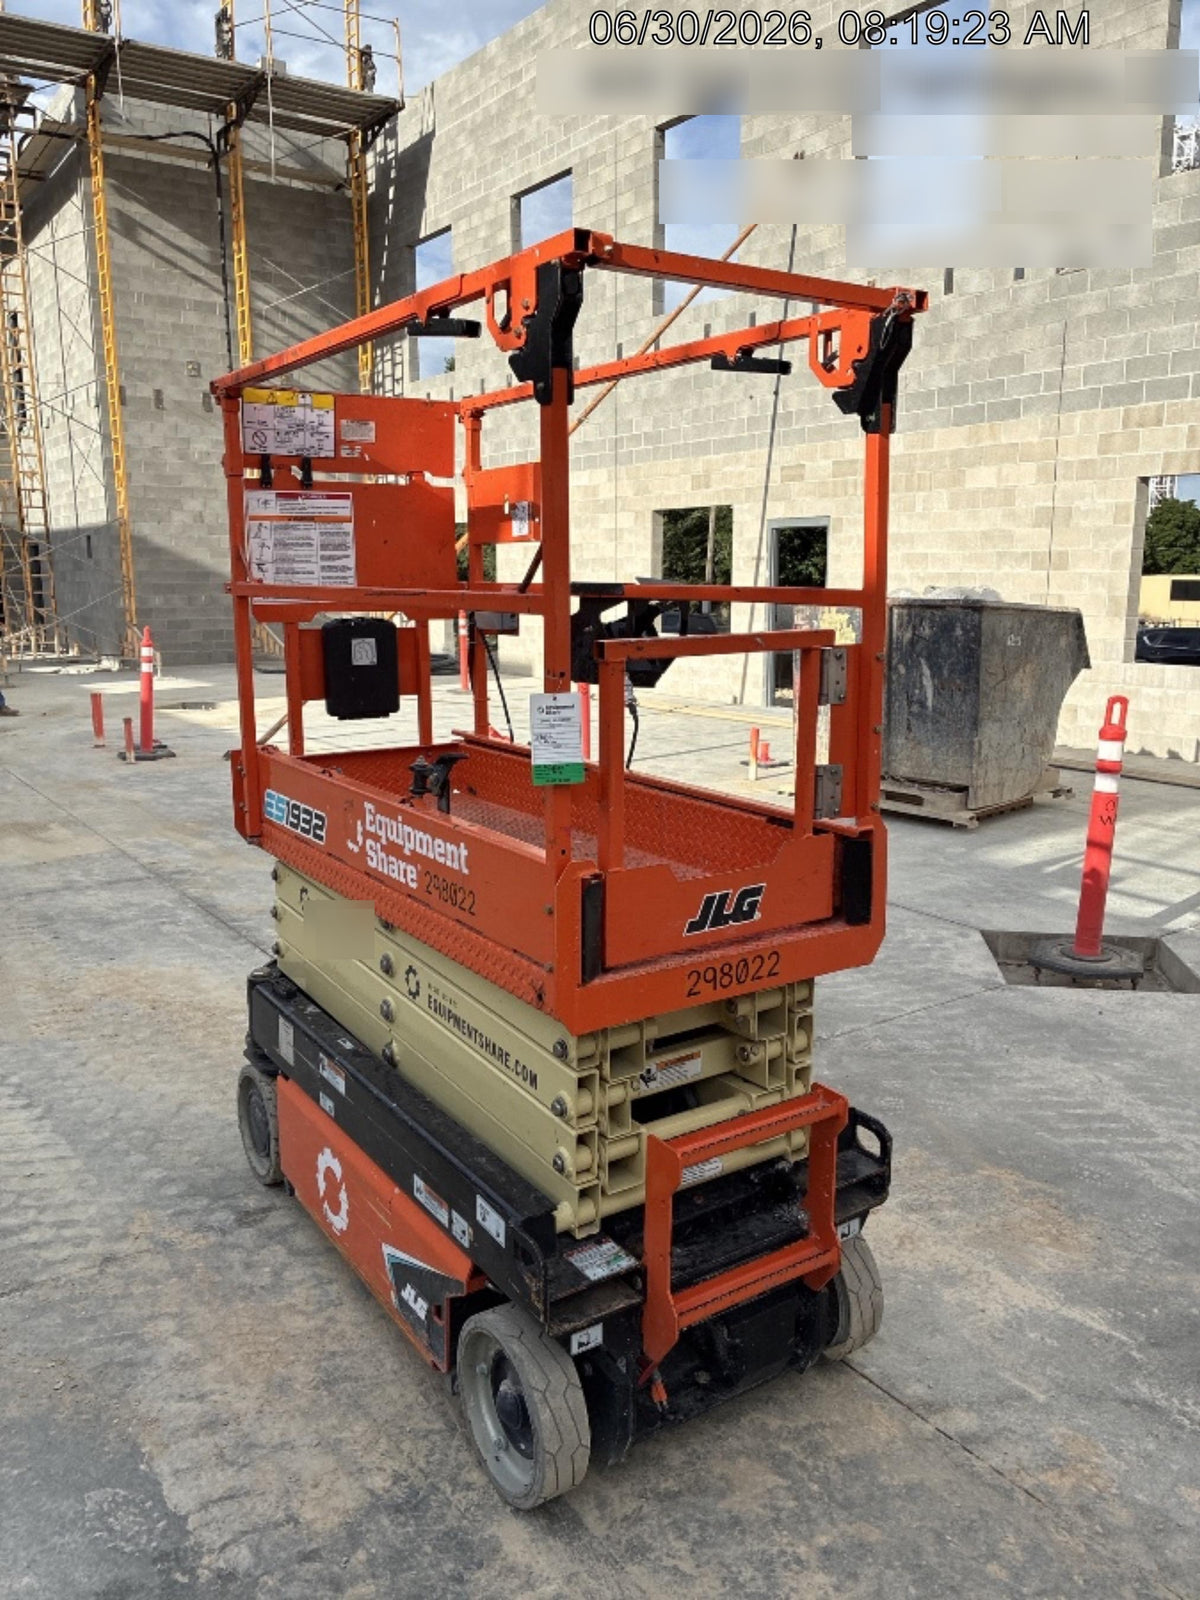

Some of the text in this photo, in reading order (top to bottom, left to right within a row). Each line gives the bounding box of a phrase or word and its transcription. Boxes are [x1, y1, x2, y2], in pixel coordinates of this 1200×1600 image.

[264, 789, 327, 845] ES1932
[364, 801, 470, 874] Equipment
[365, 838, 418, 889] Share
[424, 870, 476, 916] 298022
[683, 882, 767, 937] JLG
[686, 950, 780, 998] 298022
[427, 993, 538, 1090] EQUIPMENTSHARE.COM
